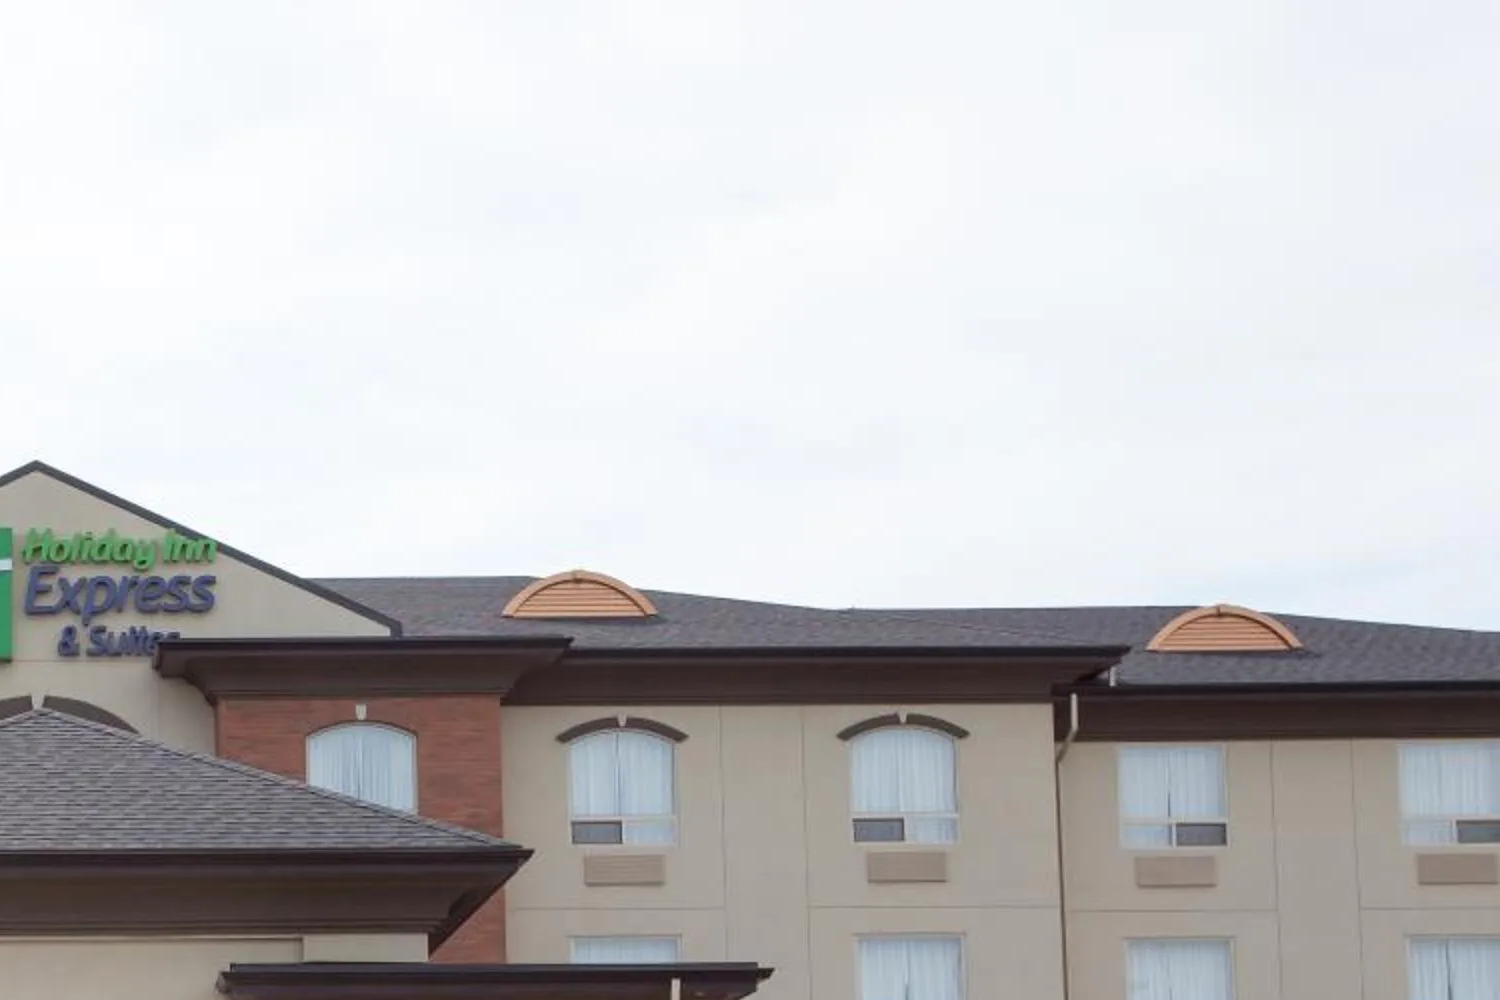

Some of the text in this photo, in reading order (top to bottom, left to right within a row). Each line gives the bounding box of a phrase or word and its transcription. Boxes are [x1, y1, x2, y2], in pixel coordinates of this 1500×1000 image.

[21, 528, 217, 571] Holiday Inn
[23, 563, 217, 627] Express
[57, 625, 80, 657] &
